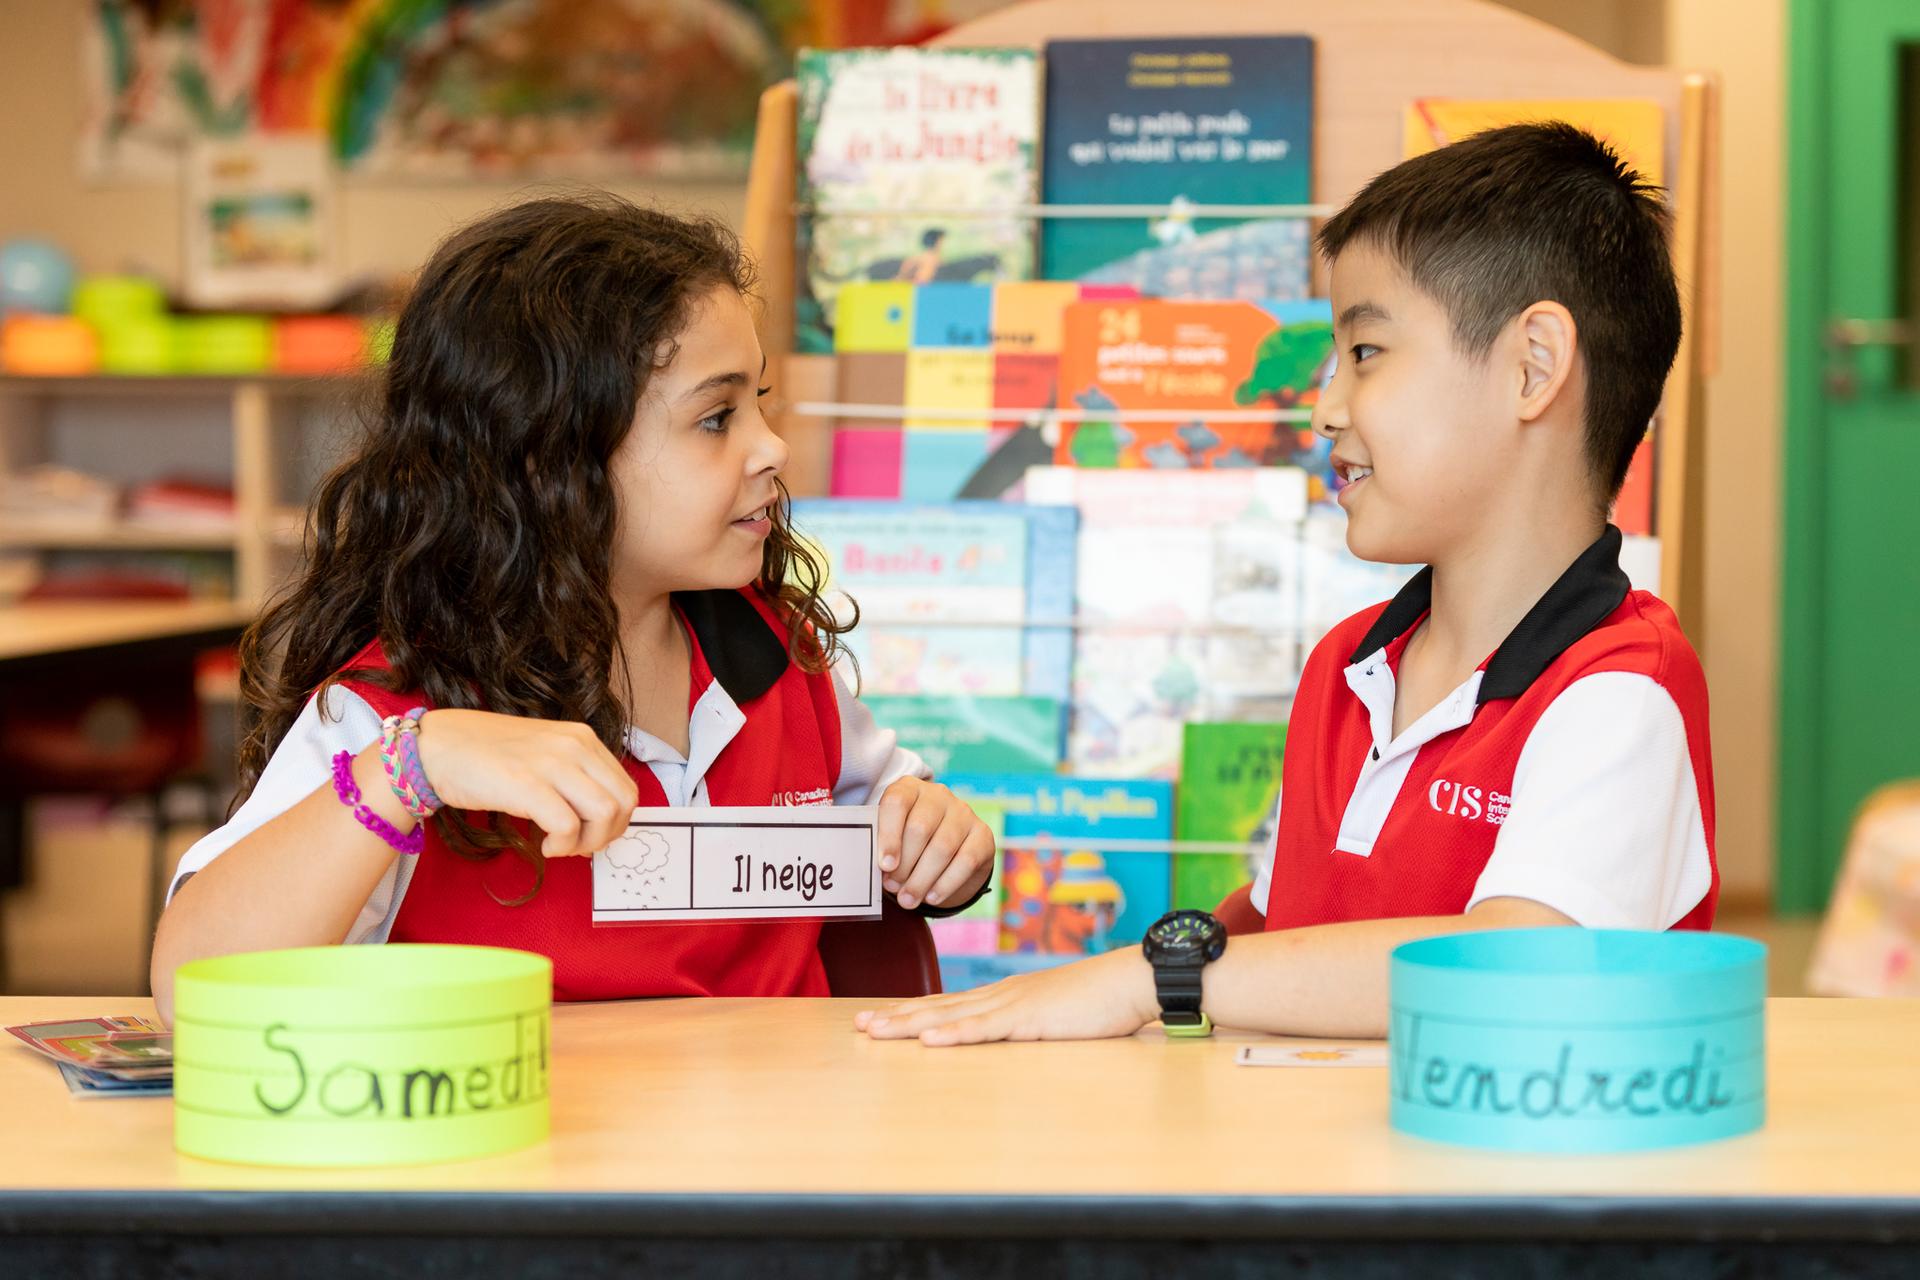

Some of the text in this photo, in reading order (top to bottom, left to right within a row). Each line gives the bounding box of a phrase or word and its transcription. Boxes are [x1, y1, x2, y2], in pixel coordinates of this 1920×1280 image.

[1098, 308, 1141, 342] 24
[1429, 779, 1482, 819] CIS
[1489, 791, 1511, 804] Can
[732, 854, 833, 901] Il neige
[1392, 1008, 1734, 1118] Vendredi
